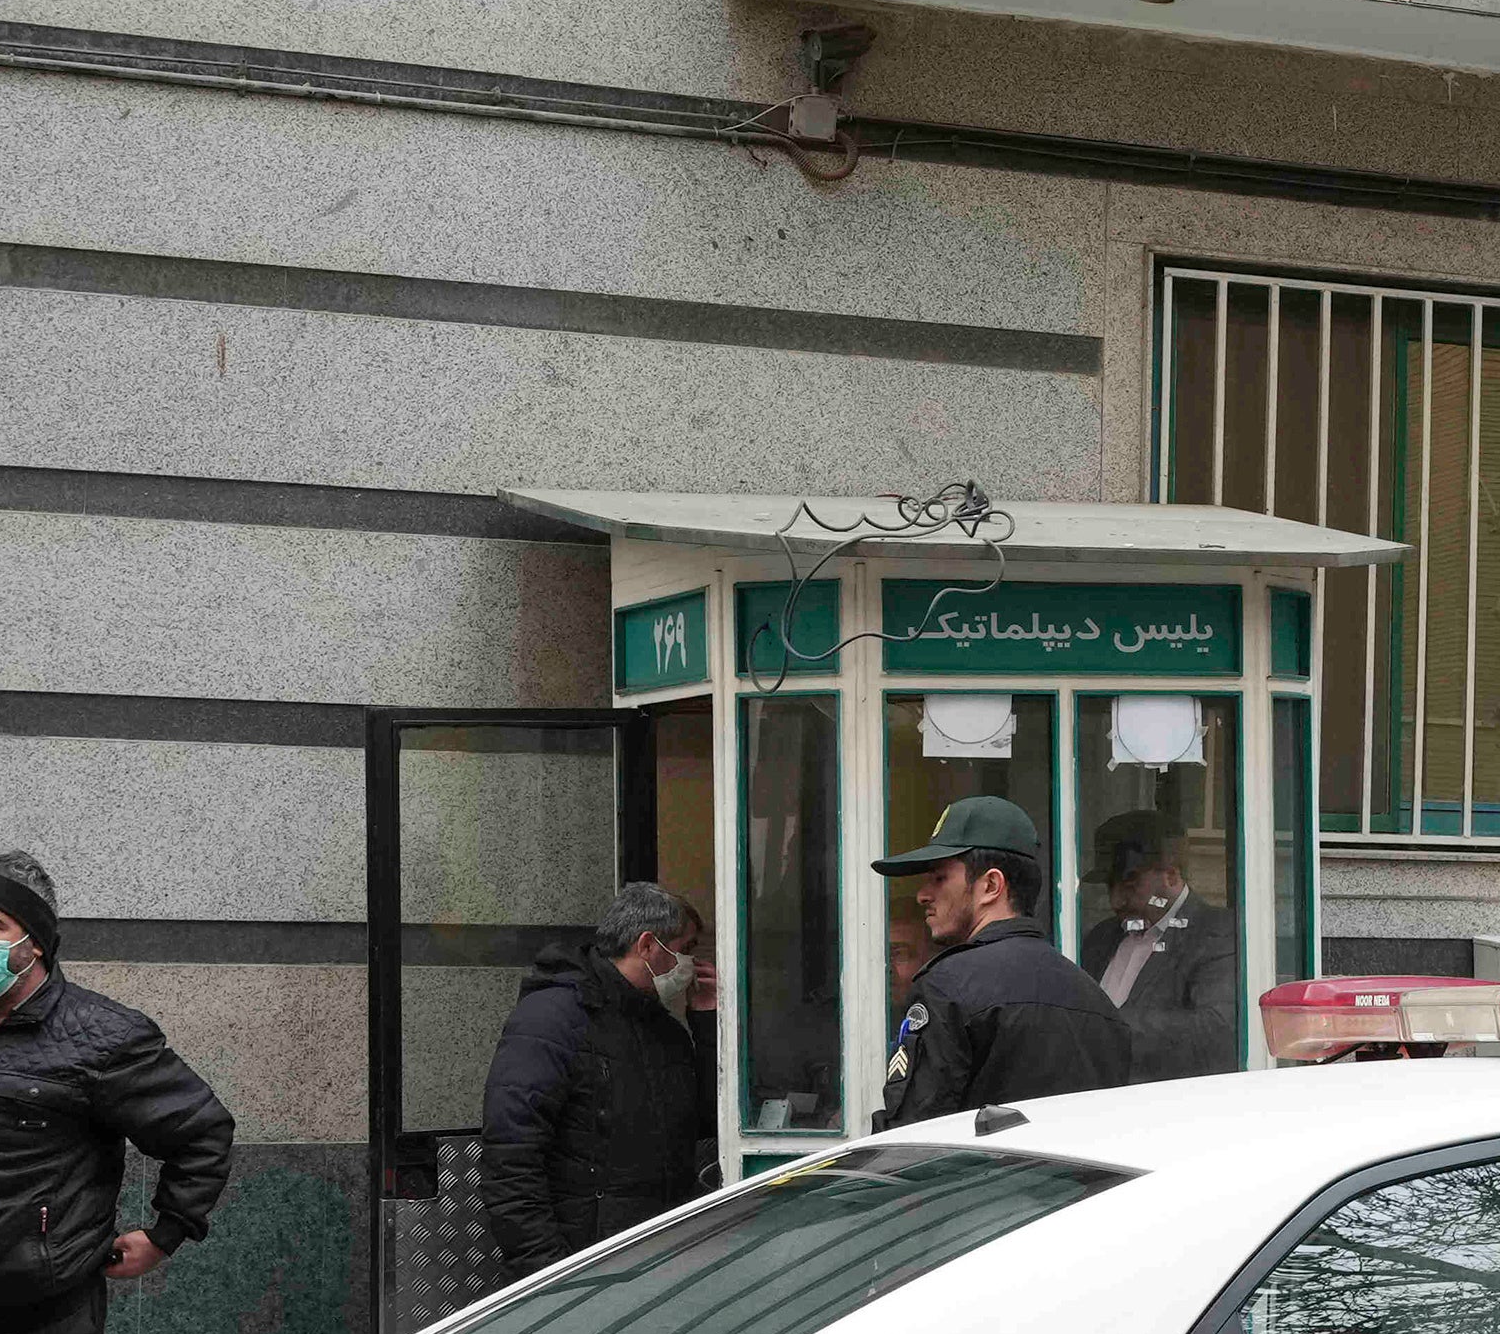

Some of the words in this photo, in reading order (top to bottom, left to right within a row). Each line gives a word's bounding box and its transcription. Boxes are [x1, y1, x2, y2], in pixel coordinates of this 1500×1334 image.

[653, 611, 687, 676] ۲۶۹
[907, 611, 1100, 652] دیپلماتیک
[1355, 995, 1373, 1006] NOOR
[1373, 994, 1390, 1006] NEDA
